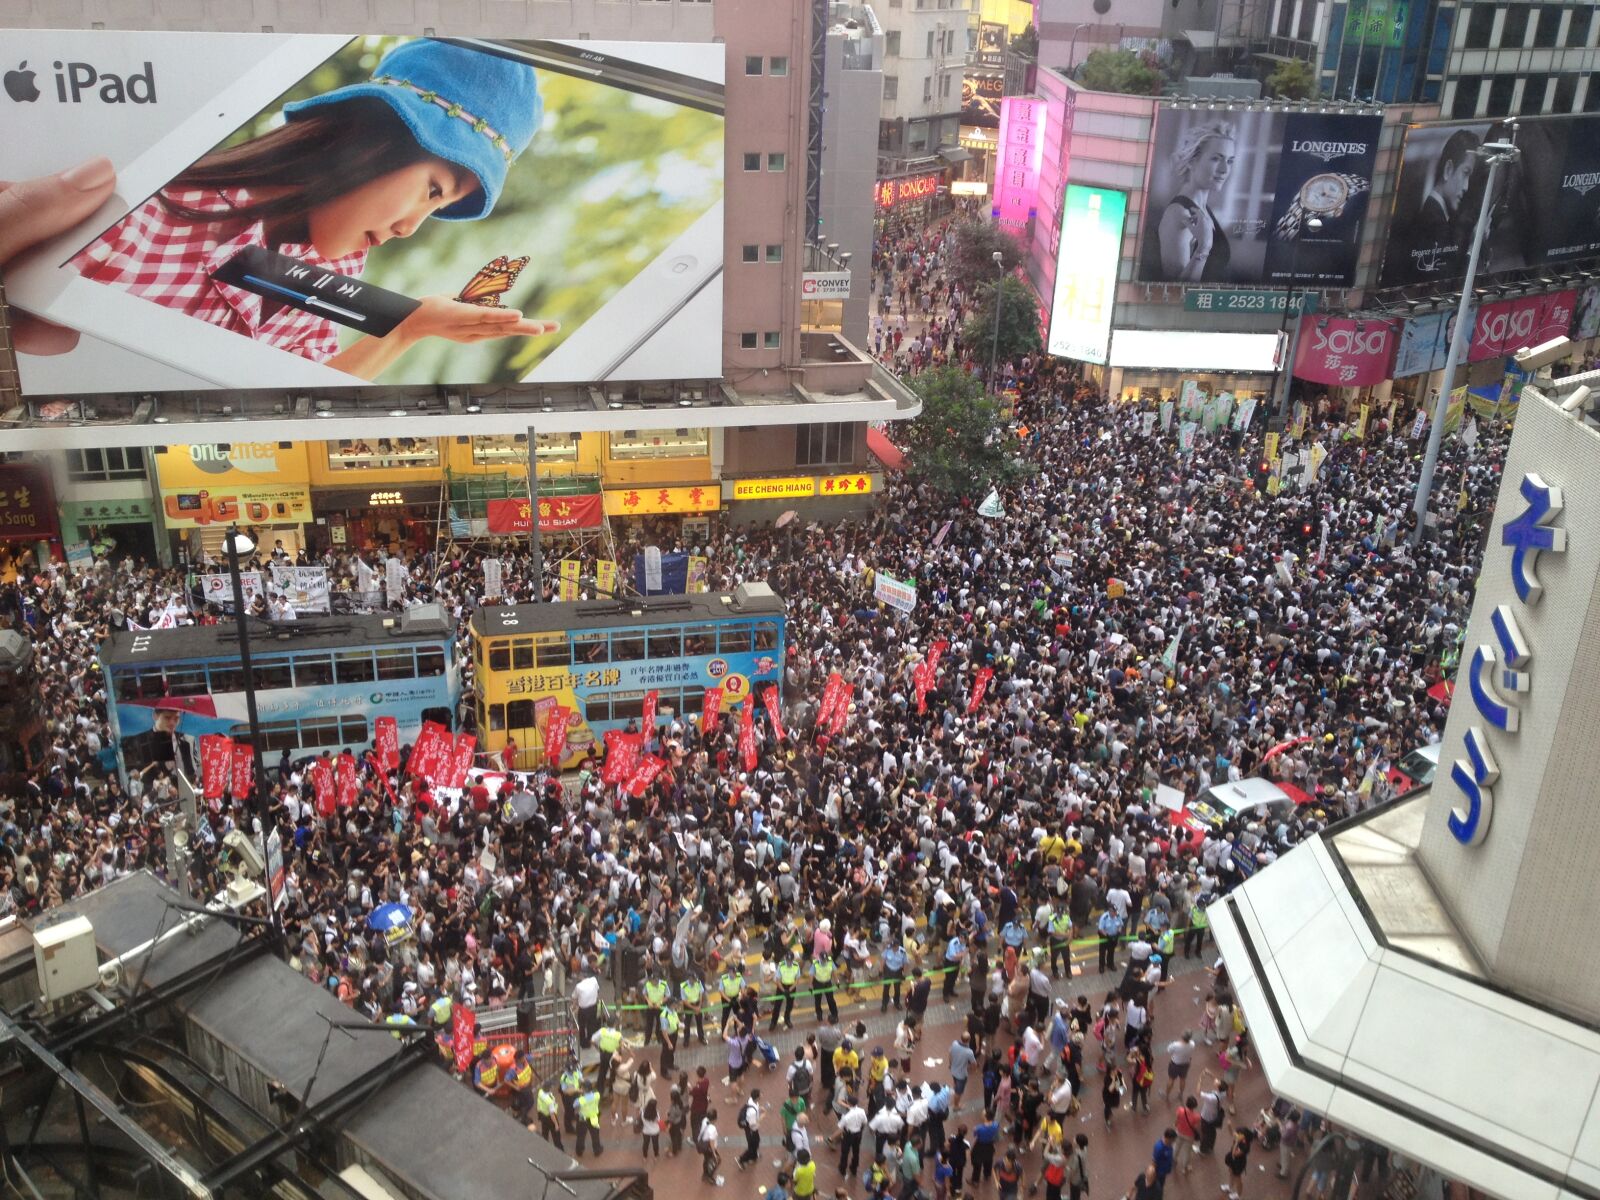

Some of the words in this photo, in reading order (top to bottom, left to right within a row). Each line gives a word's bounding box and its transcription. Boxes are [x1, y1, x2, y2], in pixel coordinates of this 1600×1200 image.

[53, 61, 157, 104] iPad
[1291, 139, 1368, 155] LONGINES
[1228, 295, 1264, 309] 2523
[1270, 297, 1303, 310] 1840
[623, 487, 704, 507] 海天堂
[737, 486, 753, 495] BEE
[755, 484, 784, 493] CHENG
[786, 483, 812, 492] HIANG
[5, 511, 36, 527] Sang
[552, 518, 578, 526] SHAN
[1448, 473, 1566, 846] そごう
[506, 668, 621, 695] 香港百年名牌
